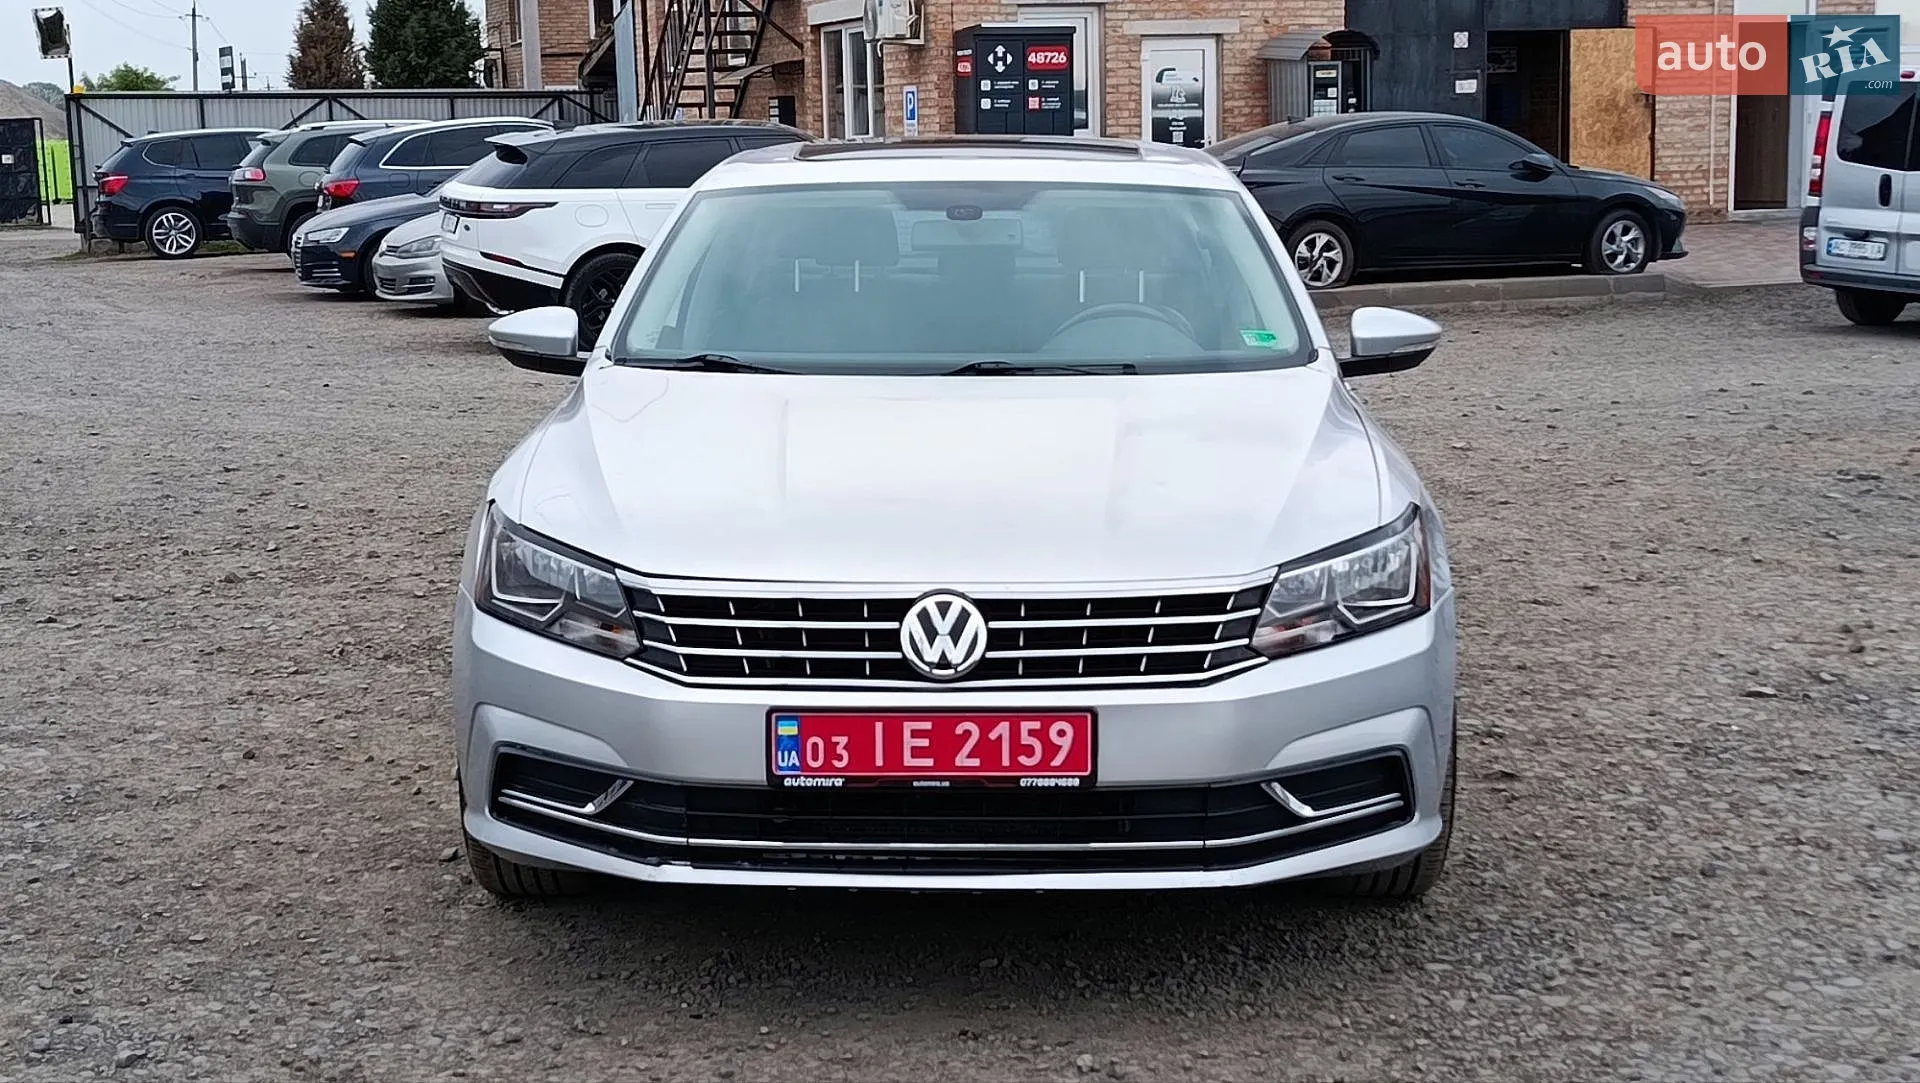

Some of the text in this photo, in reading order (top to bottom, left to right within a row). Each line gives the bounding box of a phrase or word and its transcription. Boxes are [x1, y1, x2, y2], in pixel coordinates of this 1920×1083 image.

[1027, 52, 1067, 64] 48726
[907, 92, 914, 119] P
[902, 596, 985, 673] VW
[805, 735, 849, 769] 03
[954, 720, 1075, 768] 2159
[778, 750, 800, 767] UA
